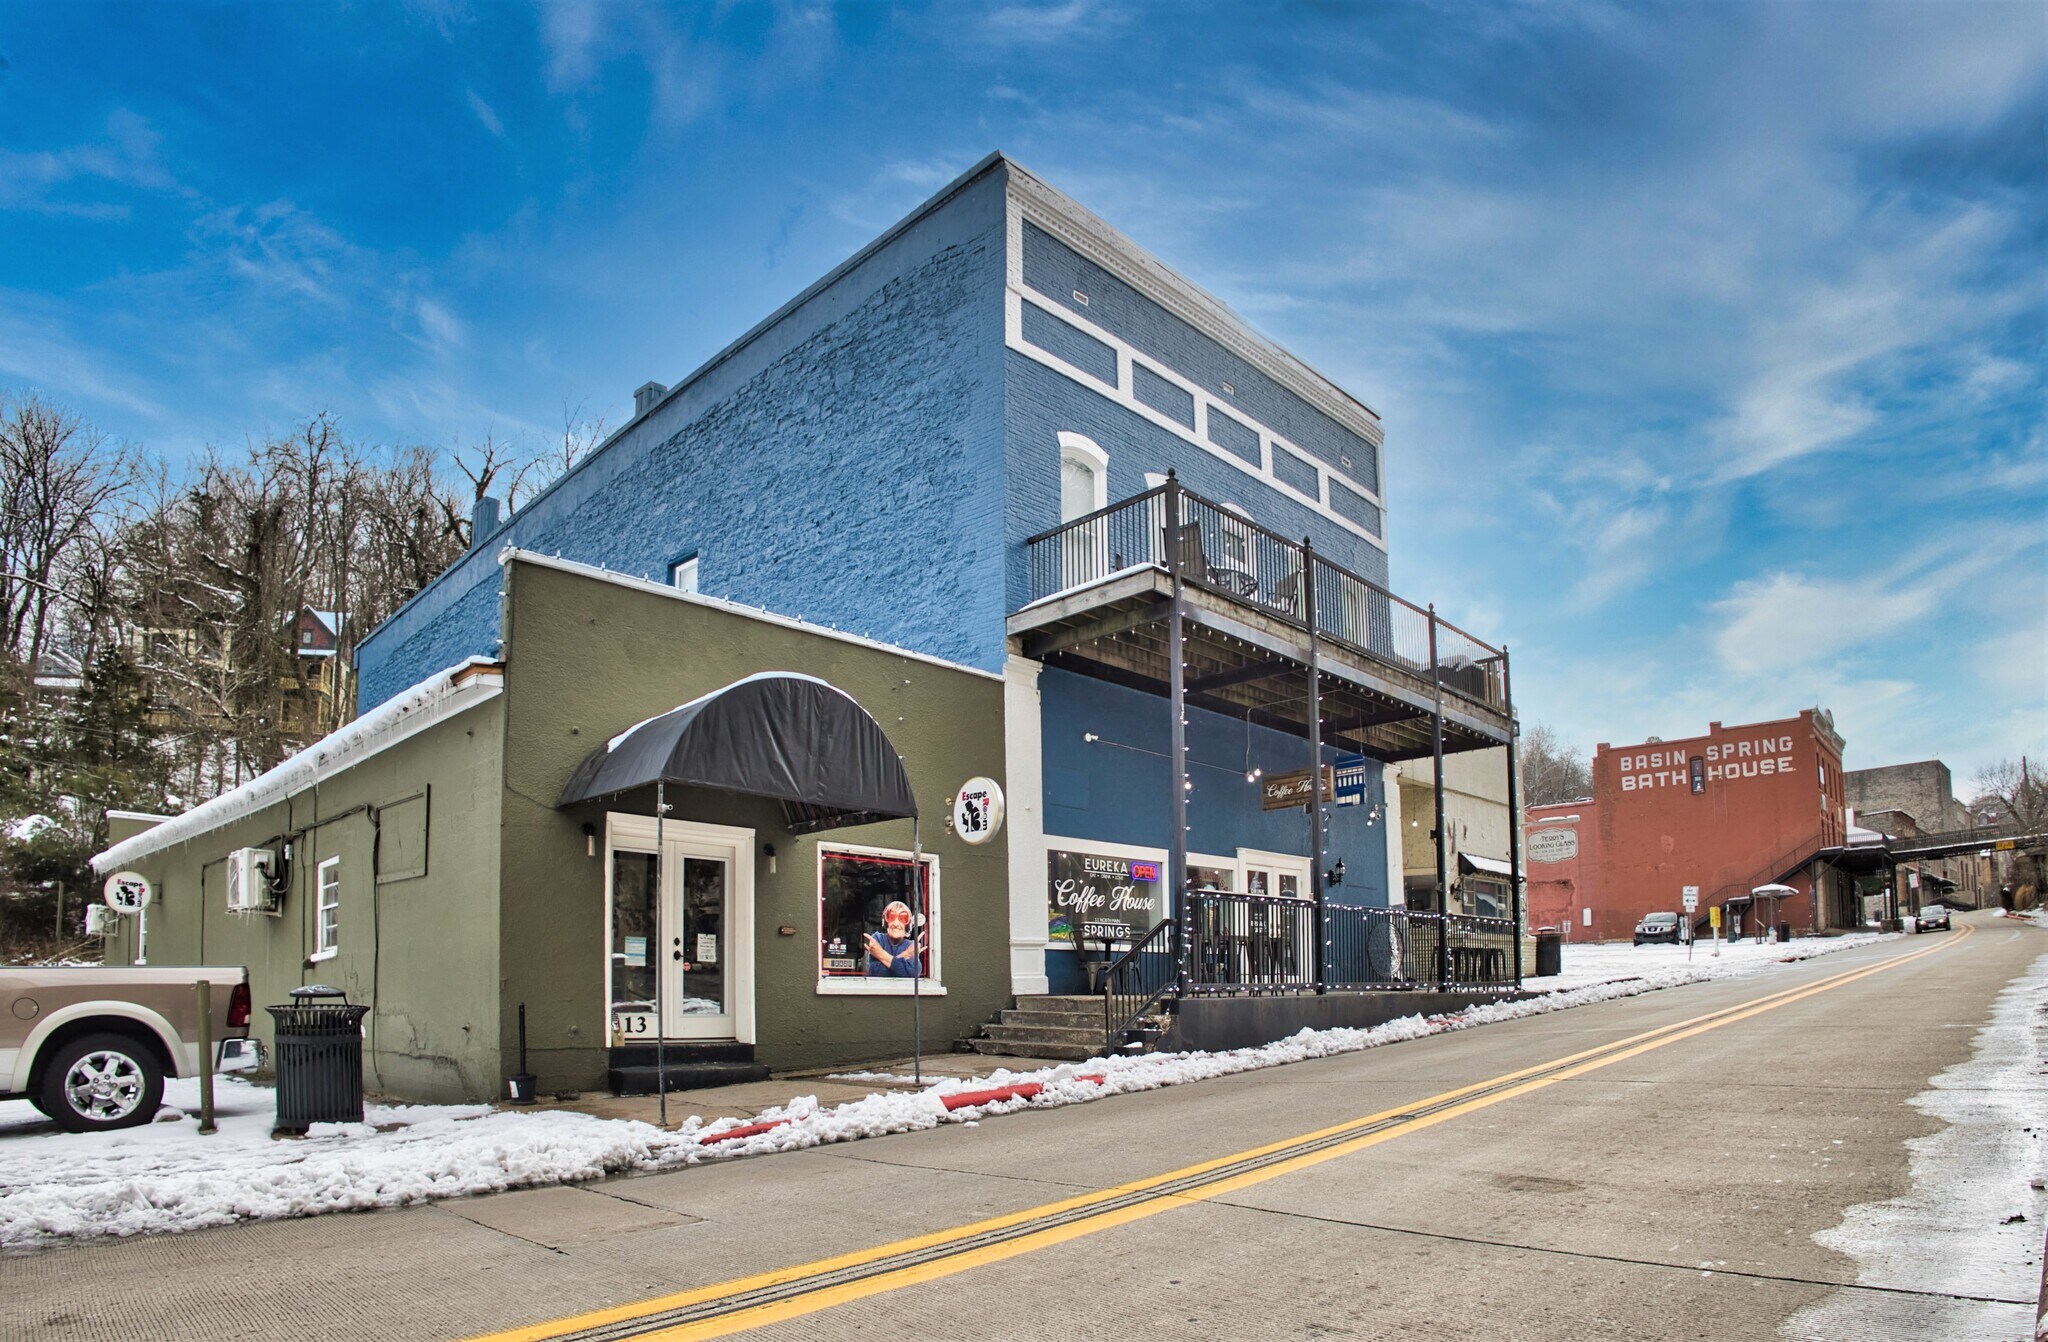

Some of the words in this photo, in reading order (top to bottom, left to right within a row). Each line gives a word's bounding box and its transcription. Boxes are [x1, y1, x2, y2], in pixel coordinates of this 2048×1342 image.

[1620, 750, 1686, 771] BASIN
[1706, 736, 1794, 761] SPRING
[1621, 769, 1687, 791] BATH
[962, 791, 987, 801] Escape
[1266, 784, 1293, 799] Coffee
[1529, 842, 1555, 850] LOOKING
[1084, 858, 1129, 874] EUREKA
[1133, 865, 1156, 879] OPEN
[117, 879, 143, 887] Escape
[1054, 879, 1106, 913] Coffee
[1109, 885, 1156, 911] House
[1083, 924, 1131, 938] SPRINGS
[624, 1016, 647, 1033] 13
